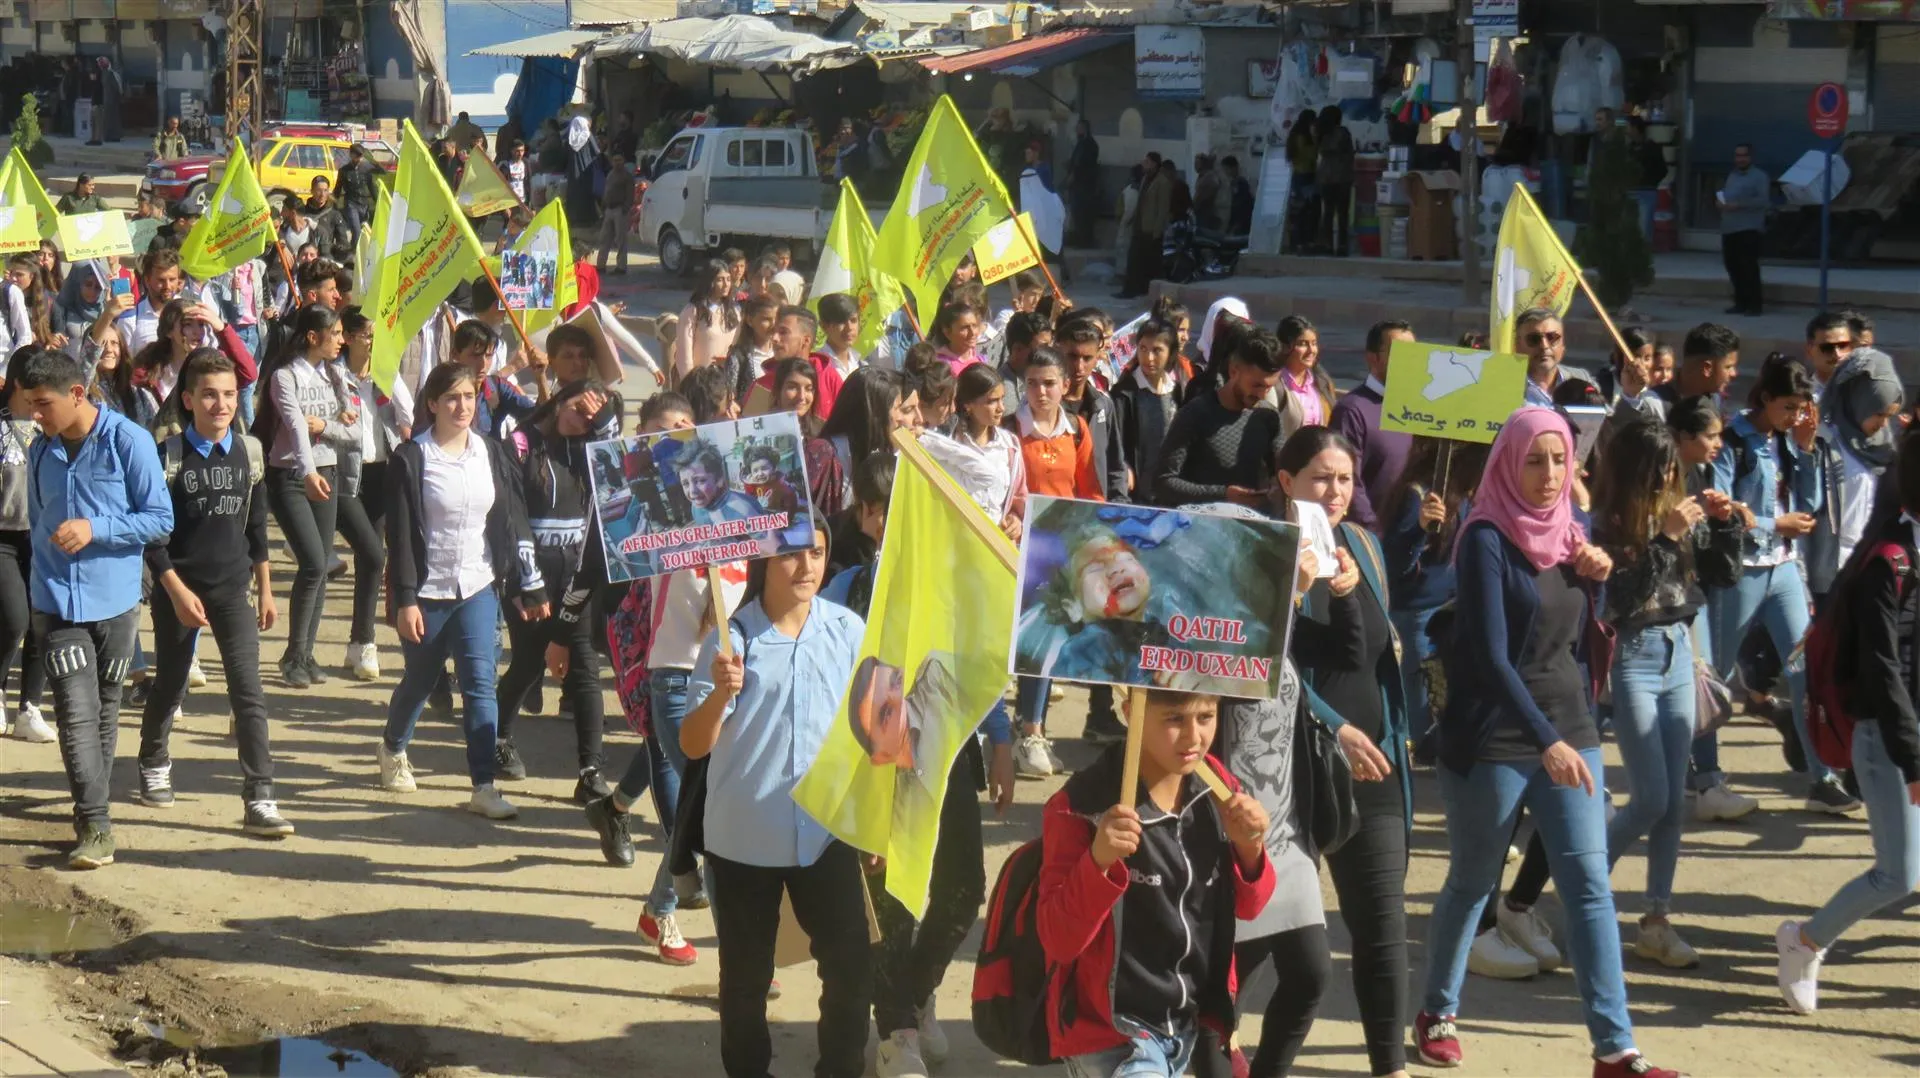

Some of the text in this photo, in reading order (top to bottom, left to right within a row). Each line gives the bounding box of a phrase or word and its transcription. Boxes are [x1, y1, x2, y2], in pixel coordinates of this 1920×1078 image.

[983, 264, 1004, 280] QSD
[623, 512, 789, 554] AFRIN IS GREATER THAN
[661, 539, 760, 571] YOUR TERROR
[1168, 614, 1247, 644] QATIL
[1139, 645, 1272, 681] ERDUXAN
